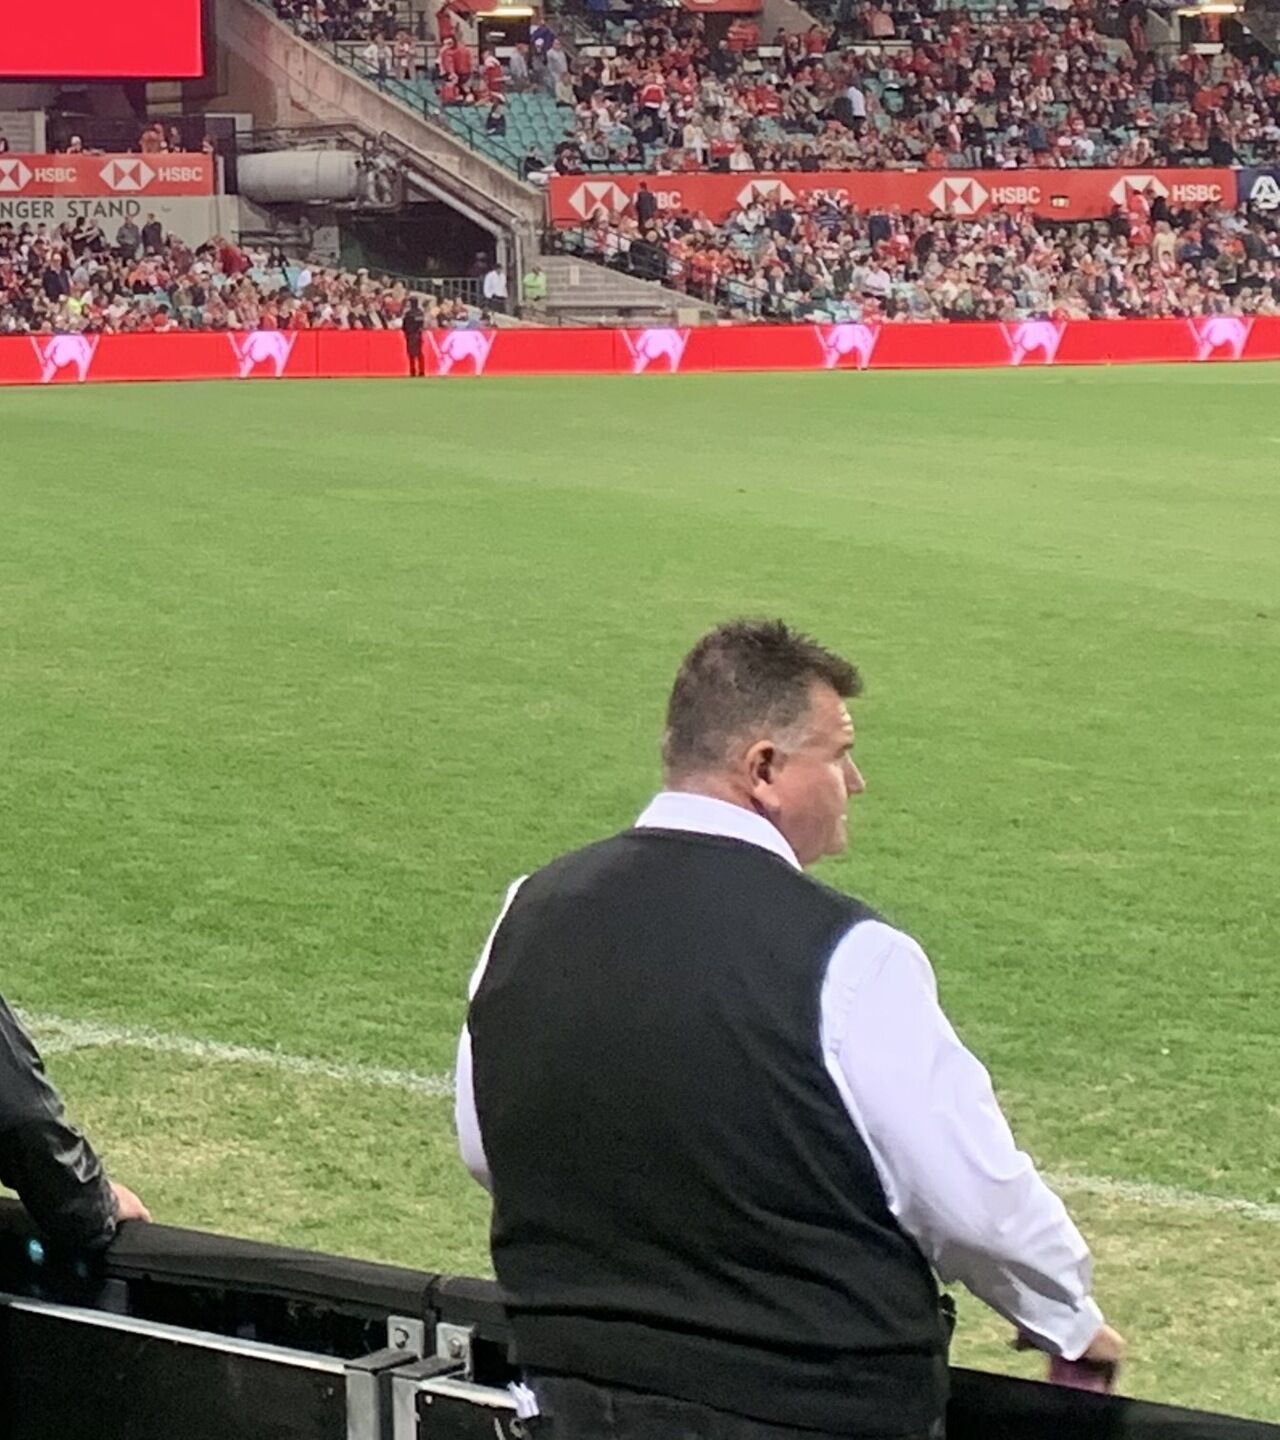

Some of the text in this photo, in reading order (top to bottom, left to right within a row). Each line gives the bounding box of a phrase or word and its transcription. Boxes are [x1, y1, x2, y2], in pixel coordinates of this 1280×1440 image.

[34, 166, 77, 182] HSBC
[158, 166, 203, 181] HSBC
[633, 191, 682, 209] BC
[991, 186, 1041, 204] HSBC
[1171, 184, 1222, 202] HSBC
[66, 199, 141, 218] STAND
